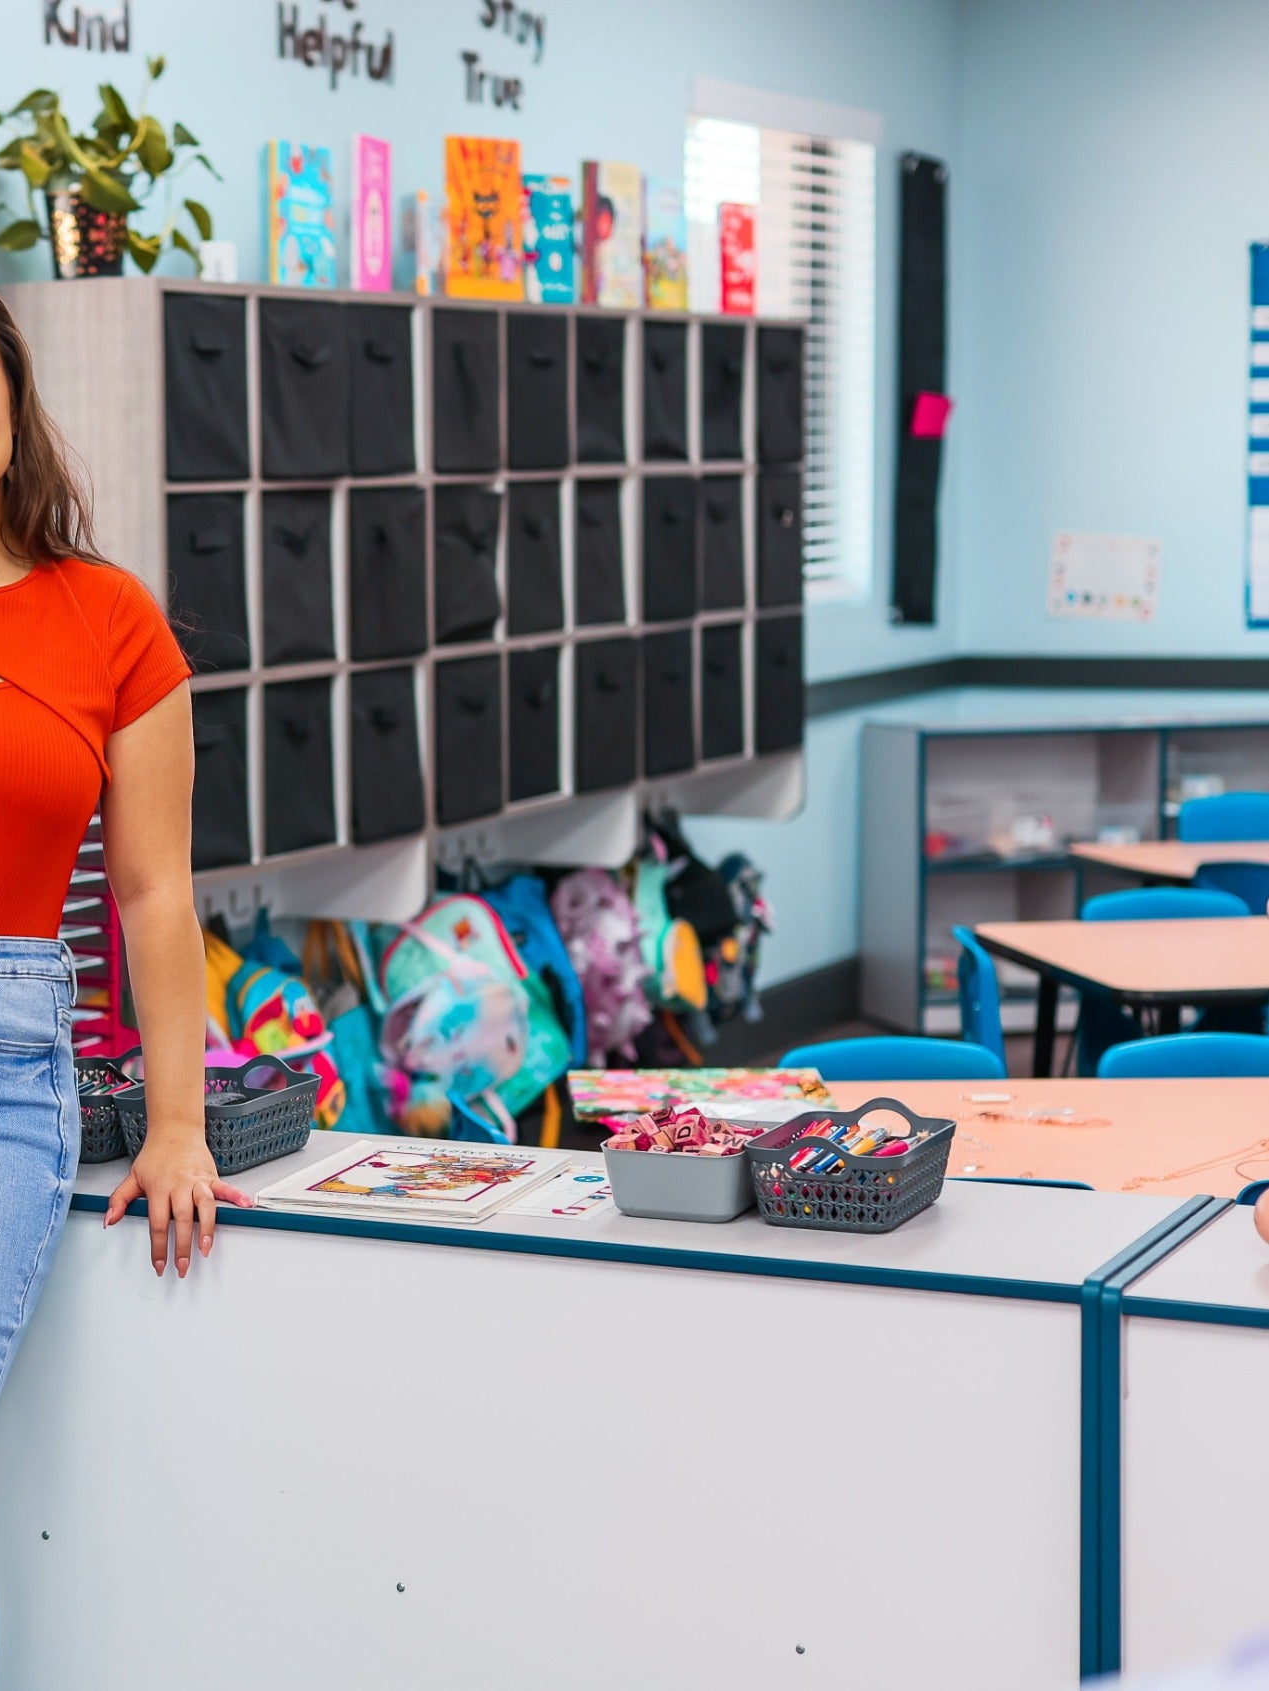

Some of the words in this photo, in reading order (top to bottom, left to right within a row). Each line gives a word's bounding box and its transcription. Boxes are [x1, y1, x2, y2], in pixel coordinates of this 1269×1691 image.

[44, 0, 131, 53] Kind
[276, 0, 395, 90] Helpful
[460, 50, 523, 112] True
[676, 1125, 692, 1140] D
